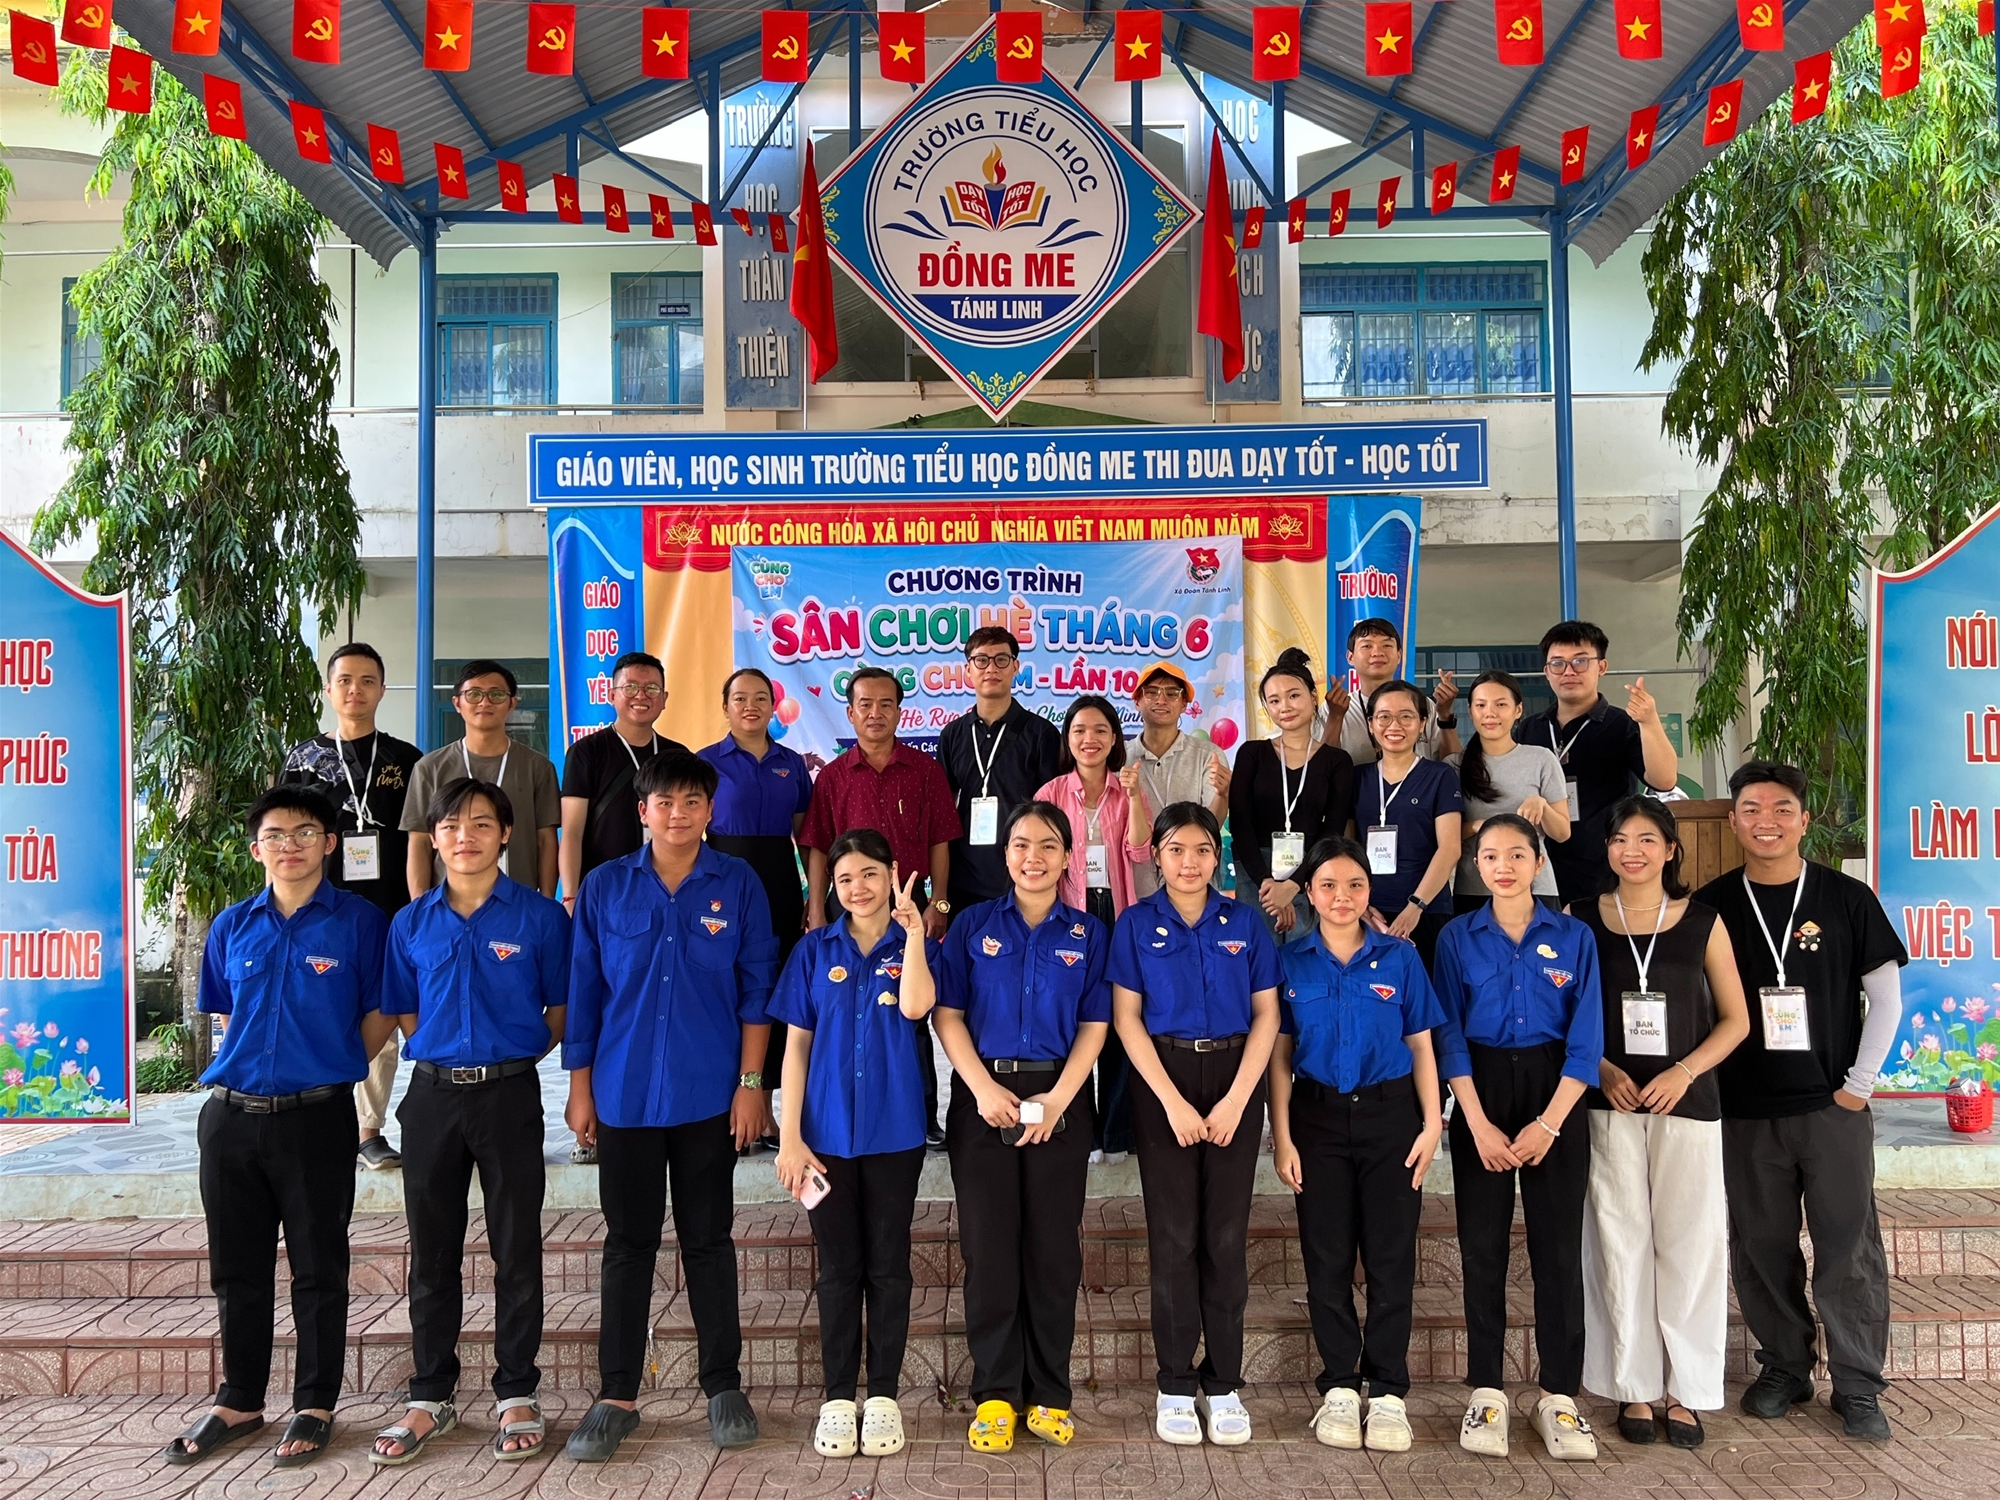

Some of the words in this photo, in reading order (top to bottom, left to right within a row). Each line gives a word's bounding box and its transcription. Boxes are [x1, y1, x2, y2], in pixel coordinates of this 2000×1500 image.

[727, 91, 793, 147] TRƯỜNG
[893, 112, 985, 192] TRƯỜNG
[995, 107, 1056, 143] TIỂU
[1055, 138, 1098, 193] HỌC
[960, 185, 984, 200] DẠY
[963, 199, 987, 219] TỐT
[1002, 198, 1025, 218] TỐT
[1006, 185, 1032, 202] HỌC
[1227, 179, 1263, 210] INH
[739, 251, 786, 302] THÂN
[918, 240, 1012, 288] ĐỒNG
[1025, 253, 1076, 288] ME
[951, 297, 997, 319] TÁNH
[1003, 300, 1043, 319] LINH
[738, 328, 790, 388] THIỆN
[556, 450, 613, 487] GIÁO
[620, 451, 683, 488] VIÊN,
[690, 454, 739, 491] HỌC
[746, 454, 804, 485] SINH
[811, 446, 903, 484] TRƯỜNG
[912, 441, 963, 483] TIỂU
[972, 451, 1019, 488] HỌC
[1025, 441, 1092, 482] ĐỒNG
[1100, 449, 1136, 480] ME
[1143, 449, 1180, 479] THI
[1187, 448, 1234, 479] ĐUA
[1242, 447, 1287, 483] DẠY
[1295, 435, 1338, 476] TỐT
[1362, 443, 1410, 480] HỌC
[1417, 431, 1460, 472] TỐT
[711, 520, 763, 546] NƯỚC
[769, 518, 822, 545] CÔNG
[828, 517, 867, 544] HÒA
[872, 517, 898, 543] XÃ
[903, 516, 935, 545] HỘI
[941, 514, 979, 543] CHỦ
[991, 515, 1049, 542] NGHĨA
[1054, 515, 1094, 542] VIỆT
[1100, 519, 1144, 541] NAM
[1150, 514, 1208, 540] MUÔN
[1214, 513, 1260, 539] NĂM
[751, 558, 790, 575] CÙNG
[756, 574, 785, 586] CHO
[888, 569, 999, 593] CHƯƠNG
[1007, 566, 1082, 594] TRÌNH
[1339, 565, 1397, 599] TRƯỜNG
[584, 577, 620, 607] GIÁO
[761, 585, 781, 598] EM
[771, 600, 861, 656] SÂN
[869, 605, 970, 646] CHƠI
[1042, 601, 1178, 649] THÁNG
[1185, 618, 1210, 652] 6
[1947, 611, 1998, 668] NÓI
[587, 631, 619, 661] DỤC
[0, 640, 52, 692] HỌC
[1055, 656, 1107, 692] LẦN
[1112, 669, 1139, 694] 10
[588, 673, 612, 703] YÊ
[900, 709, 925, 728] Hè
[0, 732, 67, 784] PHÚC
[1911, 801, 1979, 859] LÀM
[4, 827, 58, 881] TỎA
[1904, 901, 1973, 965] VIỆC
[0, 929, 100, 978] THƯƠNG
[1629, 1027, 1639, 1035] TỔ
